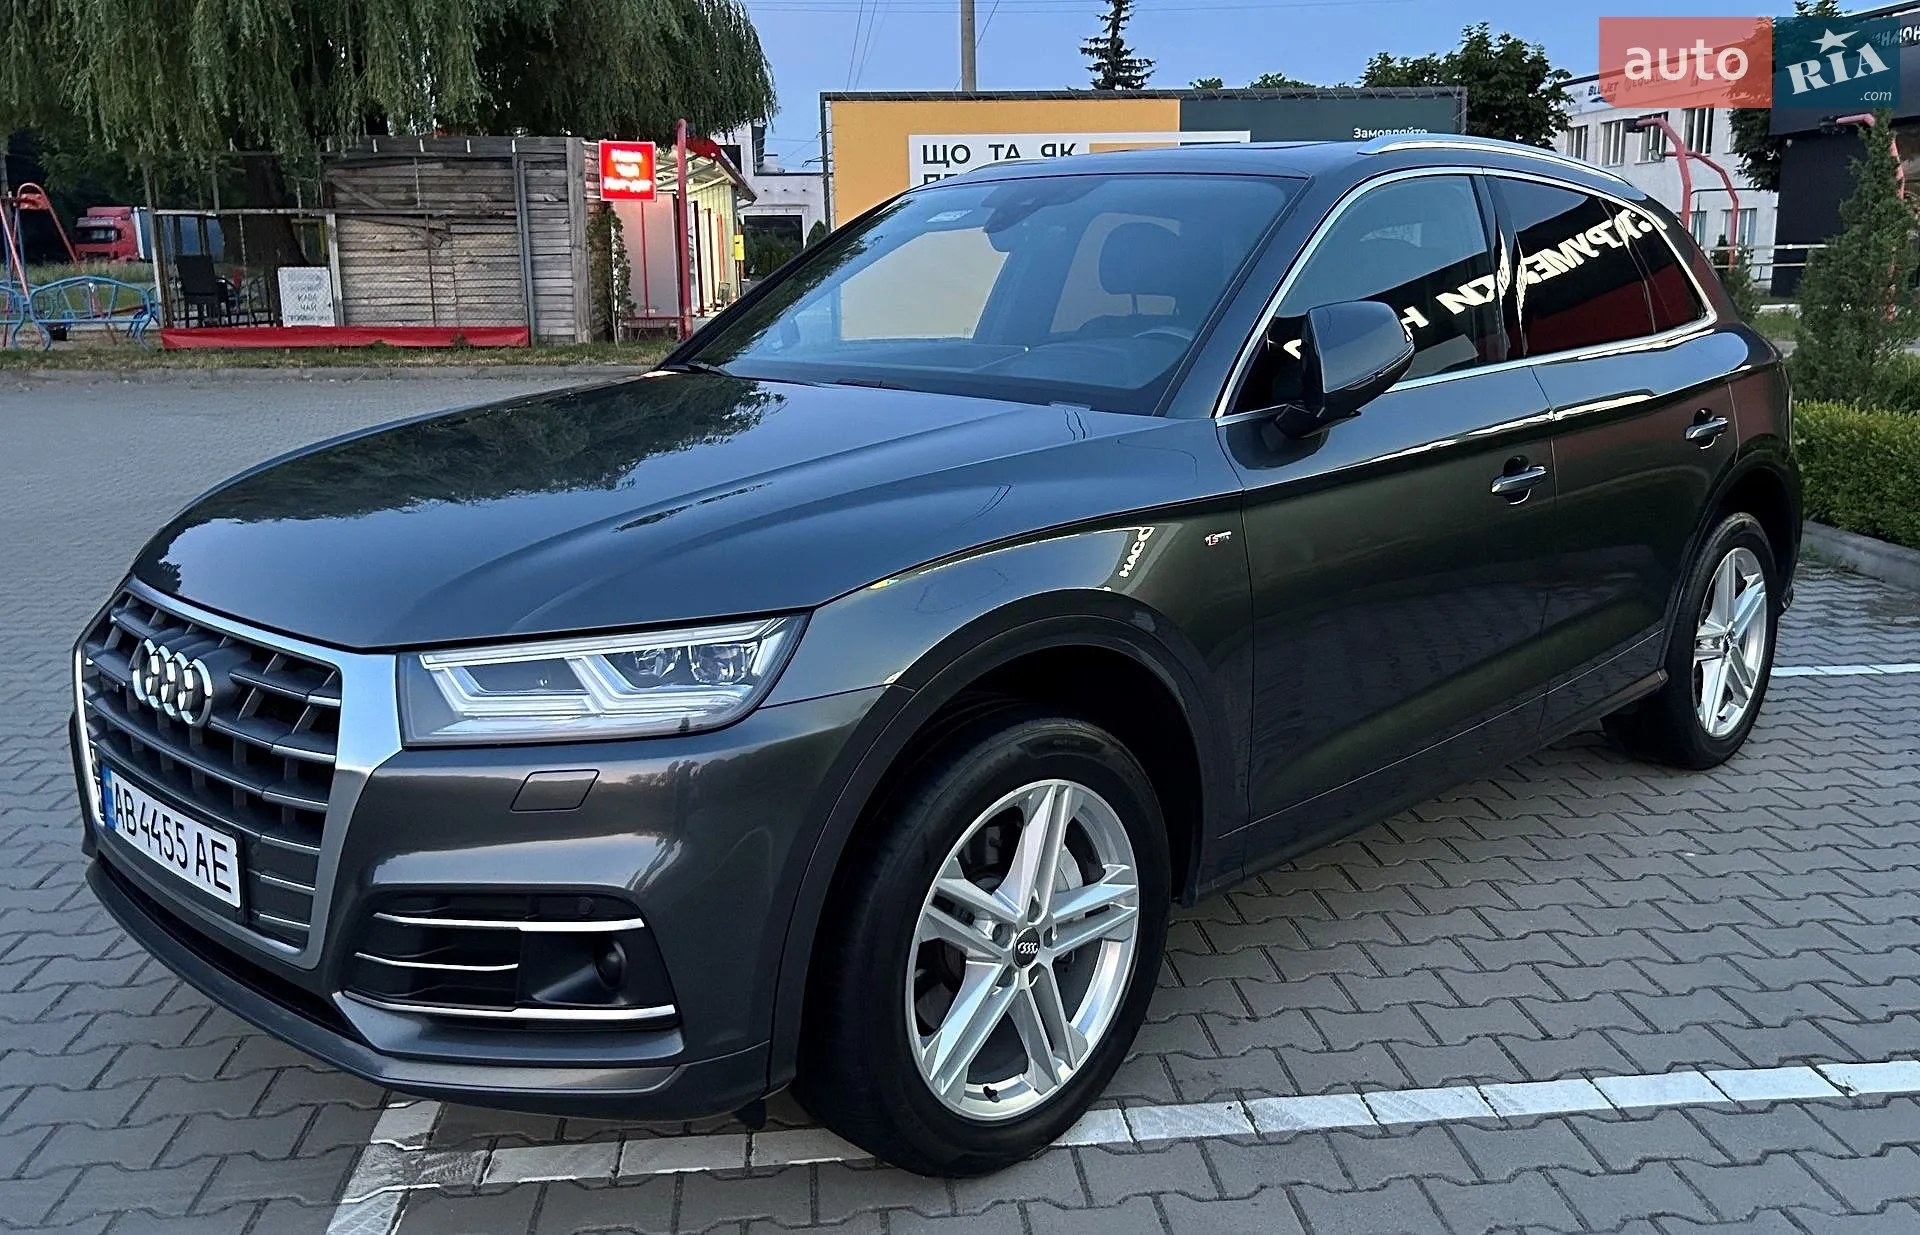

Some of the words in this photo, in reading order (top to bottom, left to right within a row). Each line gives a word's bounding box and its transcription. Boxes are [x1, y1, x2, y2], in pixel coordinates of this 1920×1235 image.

[922, 144, 971, 168] ЩО
[988, 143, 1021, 160] ТА
[1040, 143, 1077, 158] ЯК
[115, 782, 137, 837] AB
[139, 801, 189, 870] 4455
[195, 831, 232, 894] AE
